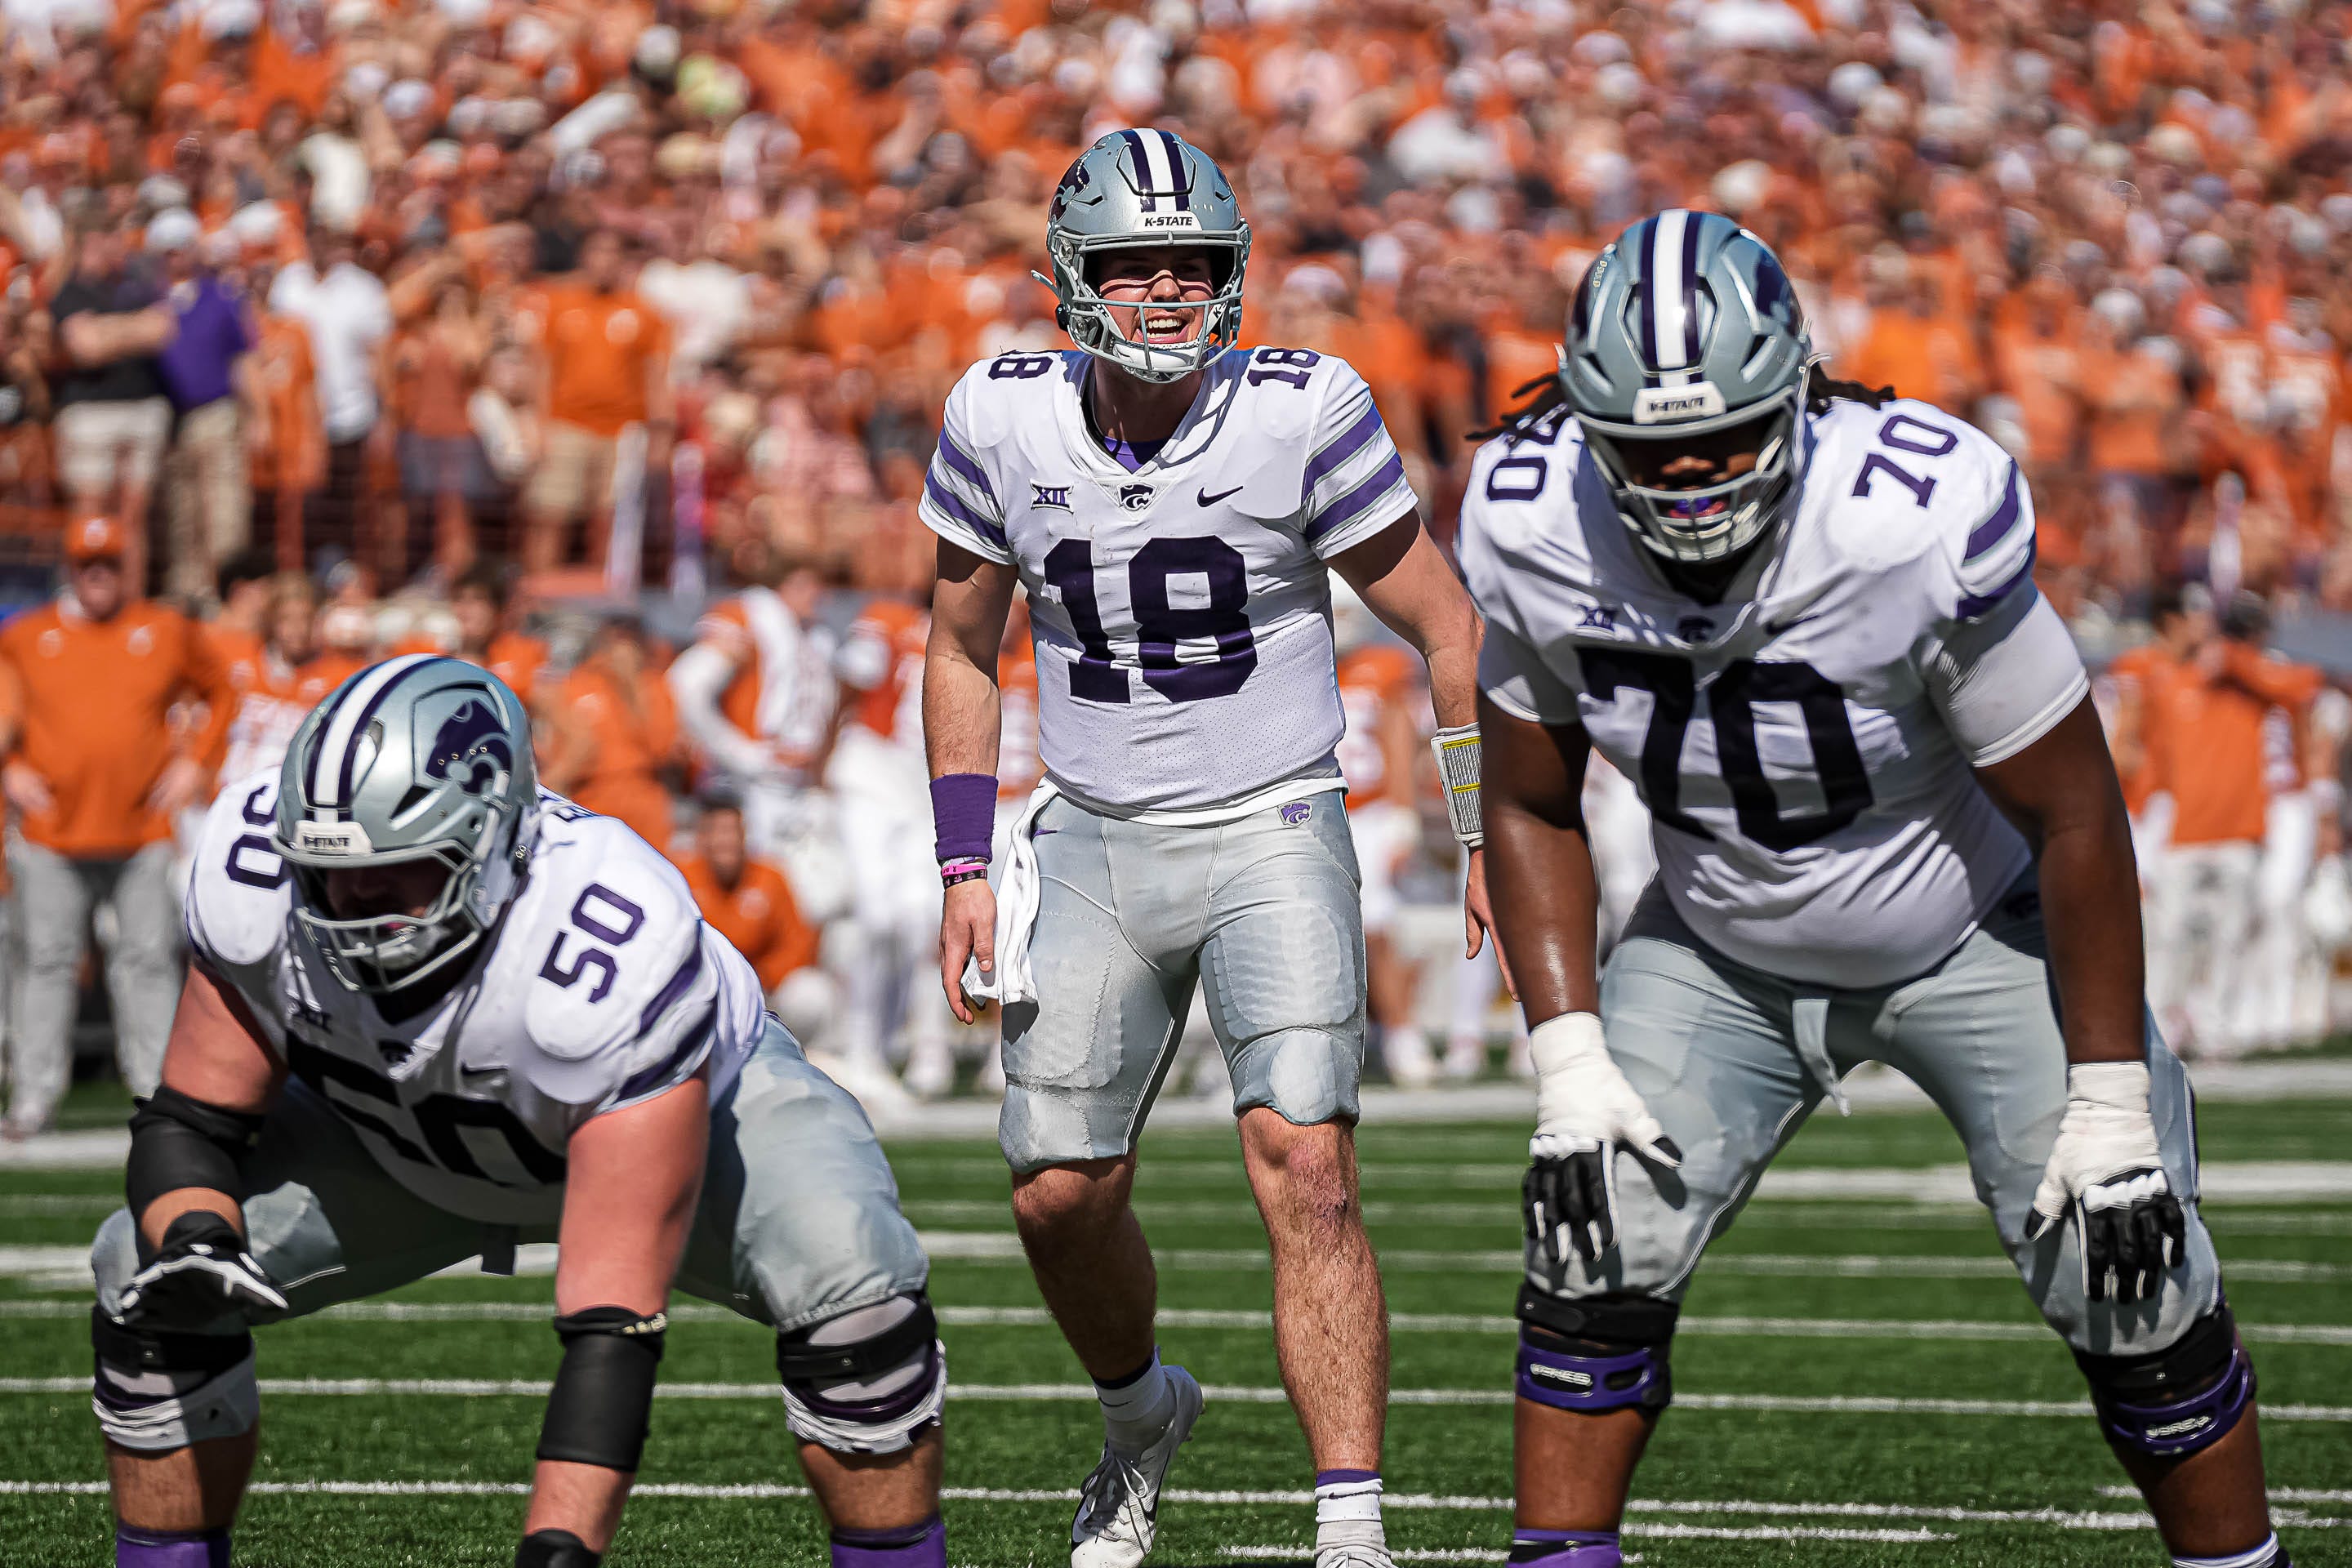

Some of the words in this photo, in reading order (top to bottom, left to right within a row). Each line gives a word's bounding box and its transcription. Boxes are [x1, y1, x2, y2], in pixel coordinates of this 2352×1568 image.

[1145, 216, 1192, 226] K-STATE
[987, 350, 1062, 381] 8
[1247, 348, 1321, 390] 18
[1852, 414, 1958, 508] 70
[1031, 483, 1071, 508] XII
[1044, 535, 1258, 704] 18
[1574, 644, 1873, 854] 70
[538, 883, 644, 1004] 50
